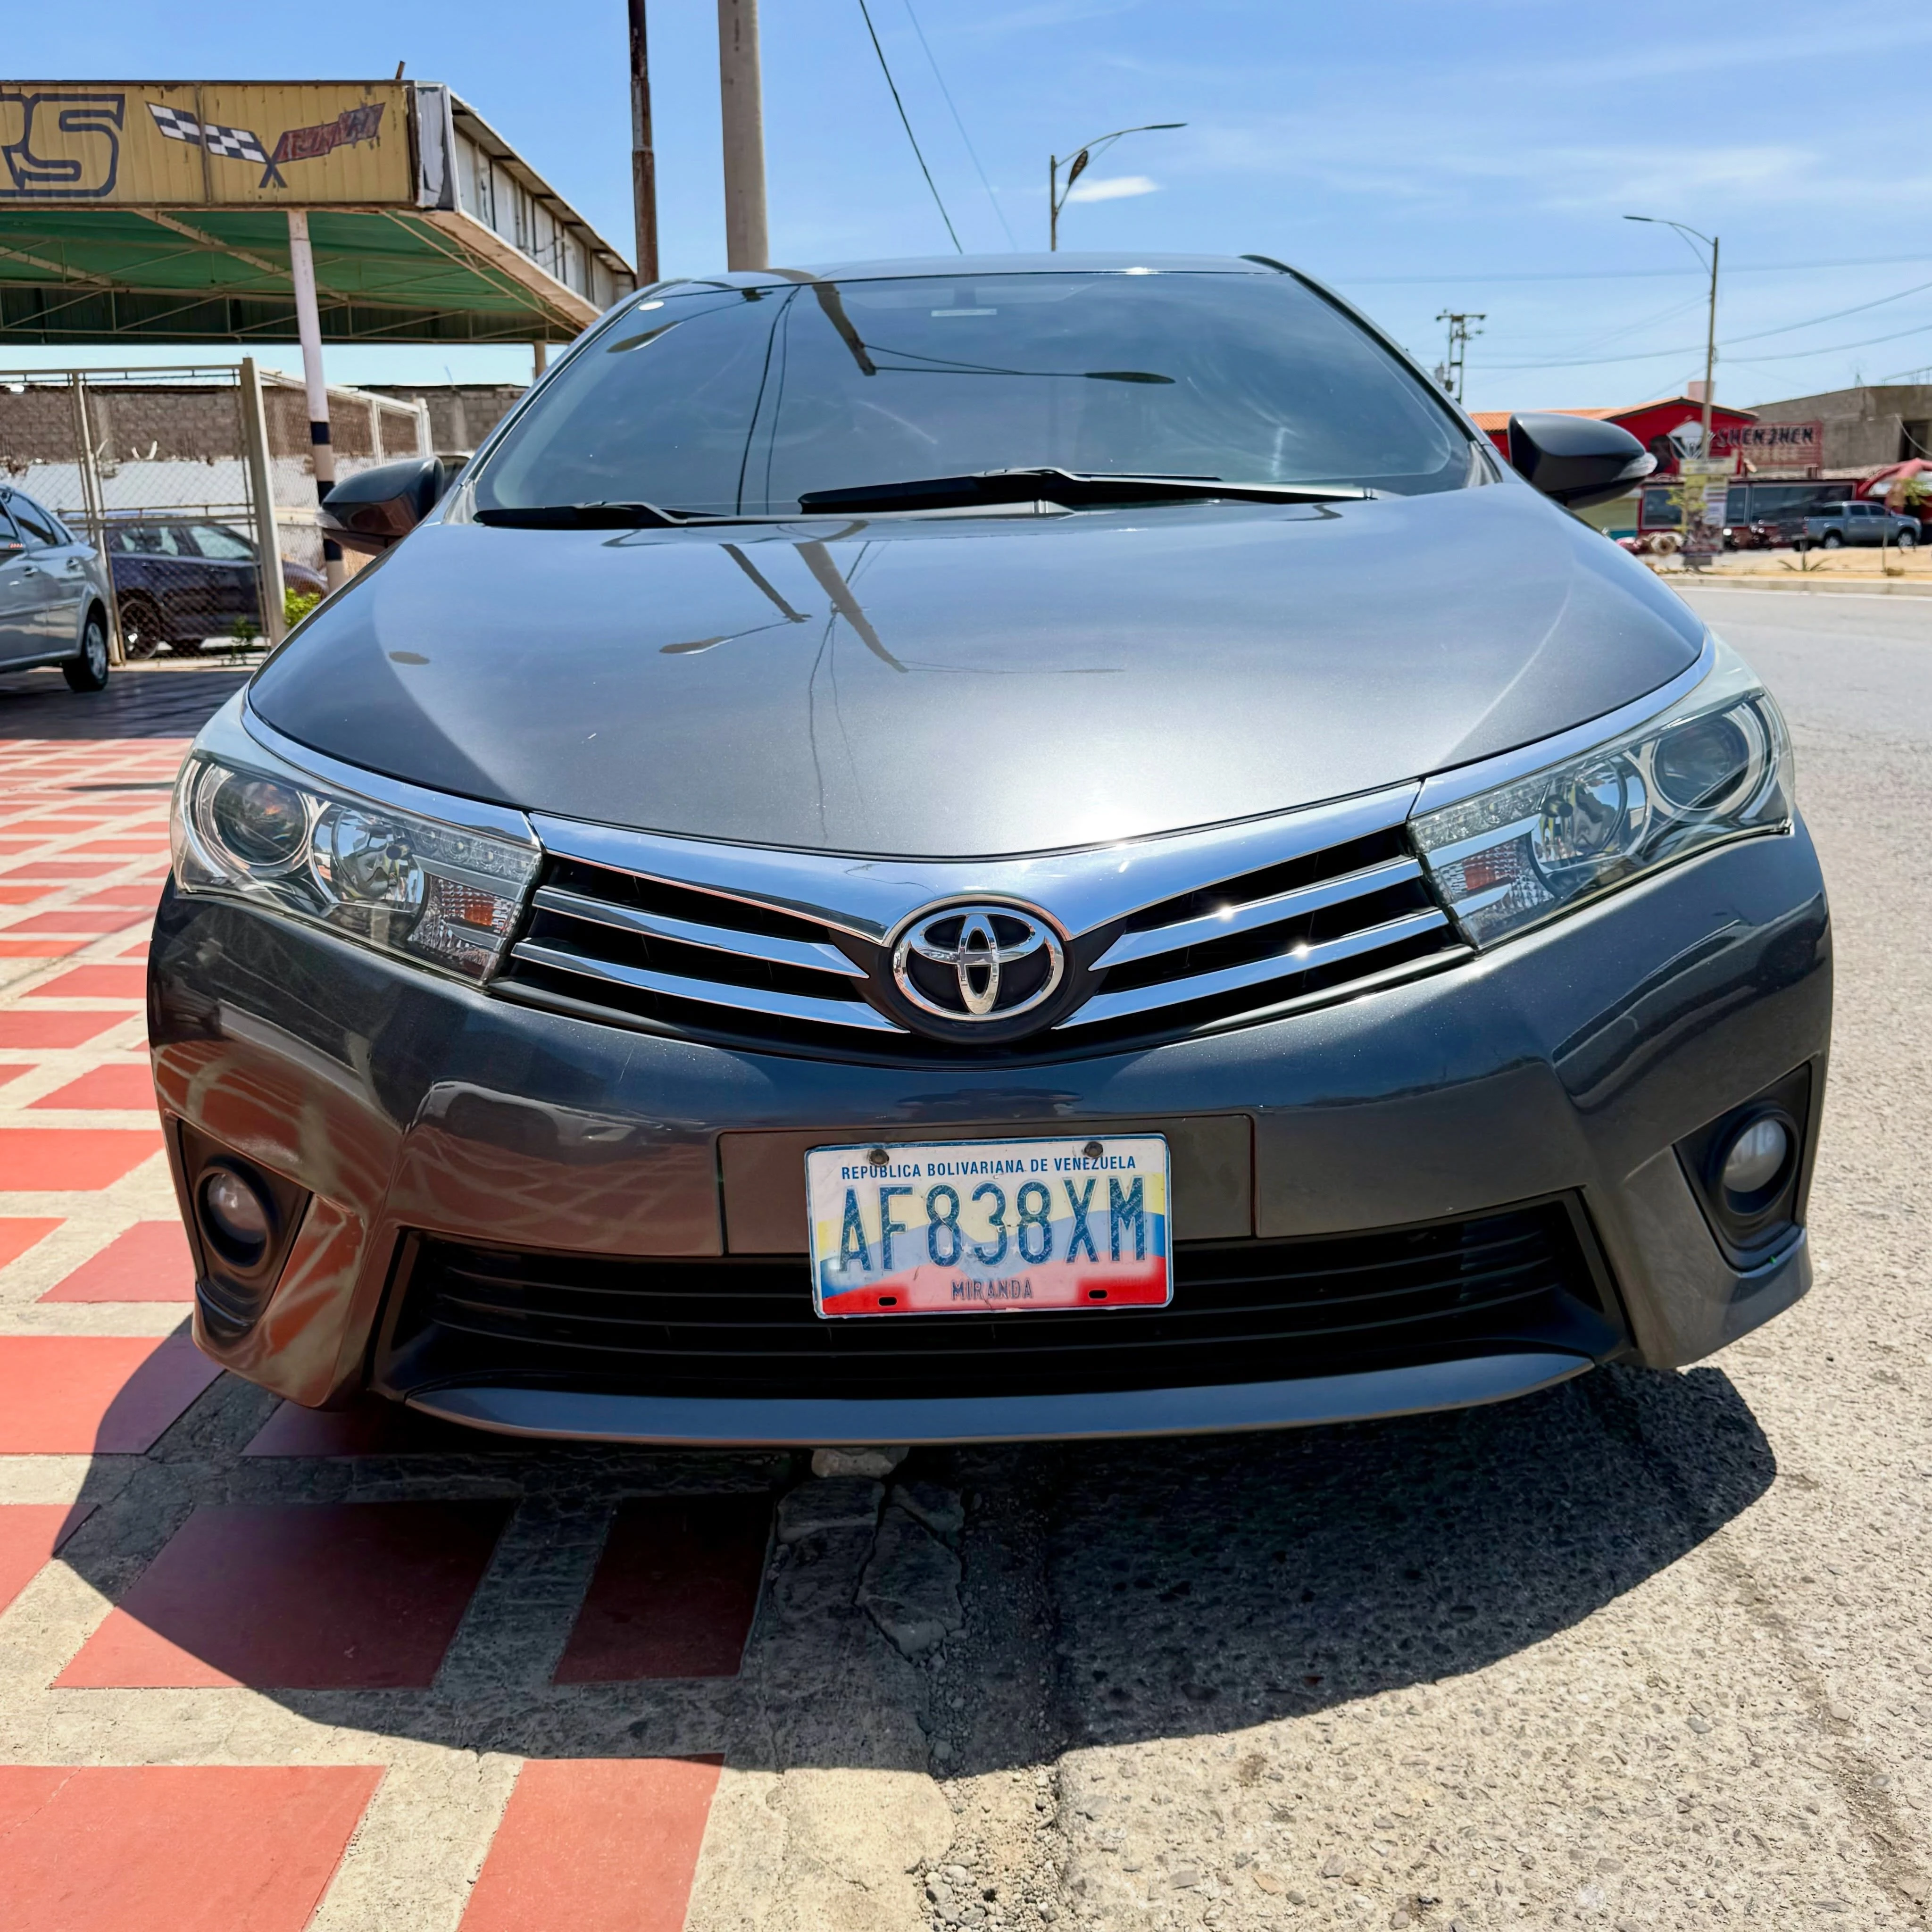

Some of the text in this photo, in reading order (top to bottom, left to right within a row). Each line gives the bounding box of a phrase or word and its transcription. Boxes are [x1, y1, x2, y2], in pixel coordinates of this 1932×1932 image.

[927, 1160, 1024, 1176] BOLIVARIANA
[1031, 1159, 1048, 1172] DE
[1054, 1156, 1136, 1171] VENEZUELA
[839, 1176, 1146, 1272] AF838XM
[951, 1279, 1033, 1300] MIRANDA
